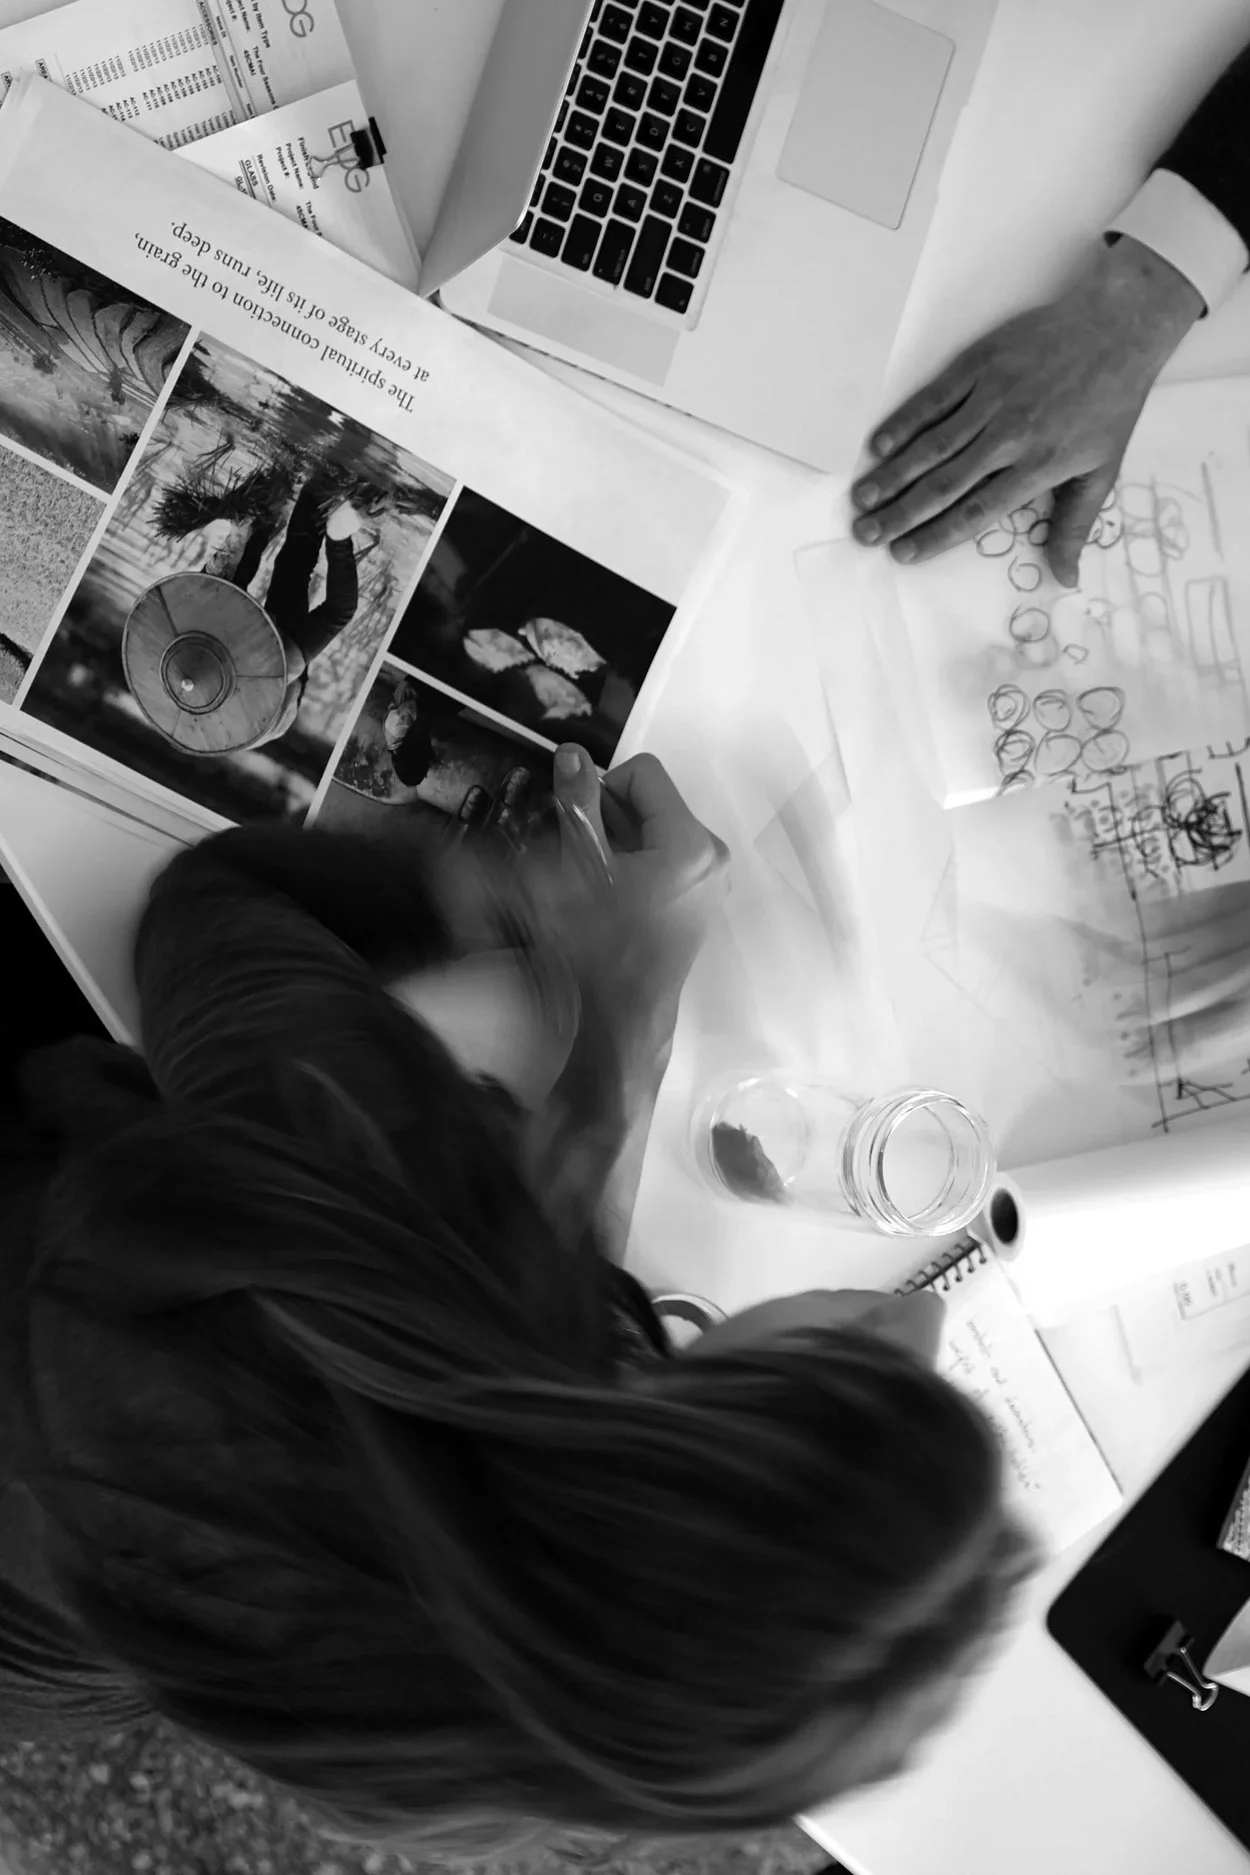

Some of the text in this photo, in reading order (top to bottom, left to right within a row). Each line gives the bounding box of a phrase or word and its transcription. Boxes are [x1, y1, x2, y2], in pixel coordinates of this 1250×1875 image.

[252, 45, 261, 58] The
[259, 30, 271, 49] Type
[256, 59, 266, 75] Four
[261, 76, 276, 104] Seasons
[273, 146, 287, 171] Project
[297, 136, 310, 161] Finish
[244, 159, 258, 187] GLASS
[256, 153, 271, 184] Revision
[283, 142, 297, 167] Project
[304, 200, 314, 214] The
[171, 222, 430, 382] at every stage of its life, runs deep.
[134, 232, 414, 410] The spiritual connection to the grain,
